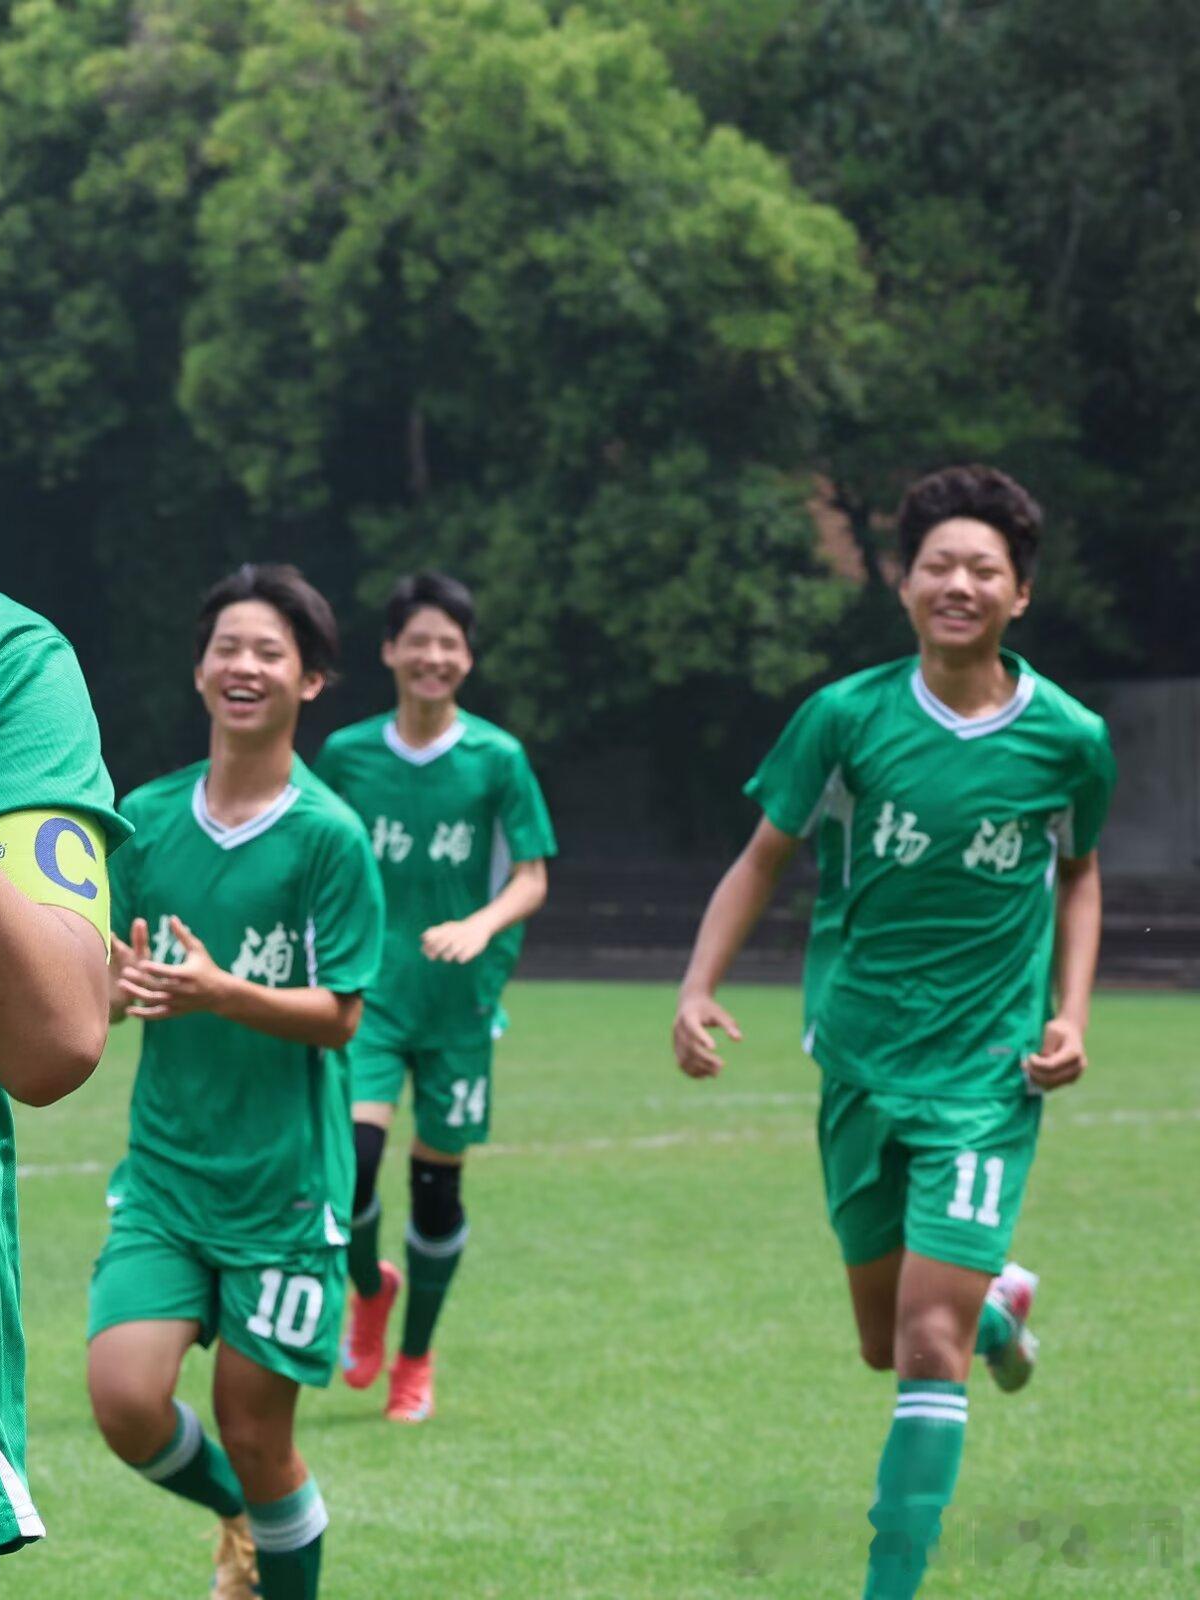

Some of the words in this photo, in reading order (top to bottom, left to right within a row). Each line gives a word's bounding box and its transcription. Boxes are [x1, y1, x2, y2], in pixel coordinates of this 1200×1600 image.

[35, 817, 98, 900] C
[445, 1077, 488, 1127] 14
[947, 1150, 1004, 1228] 11
[246, 1268, 323, 1348] 10
